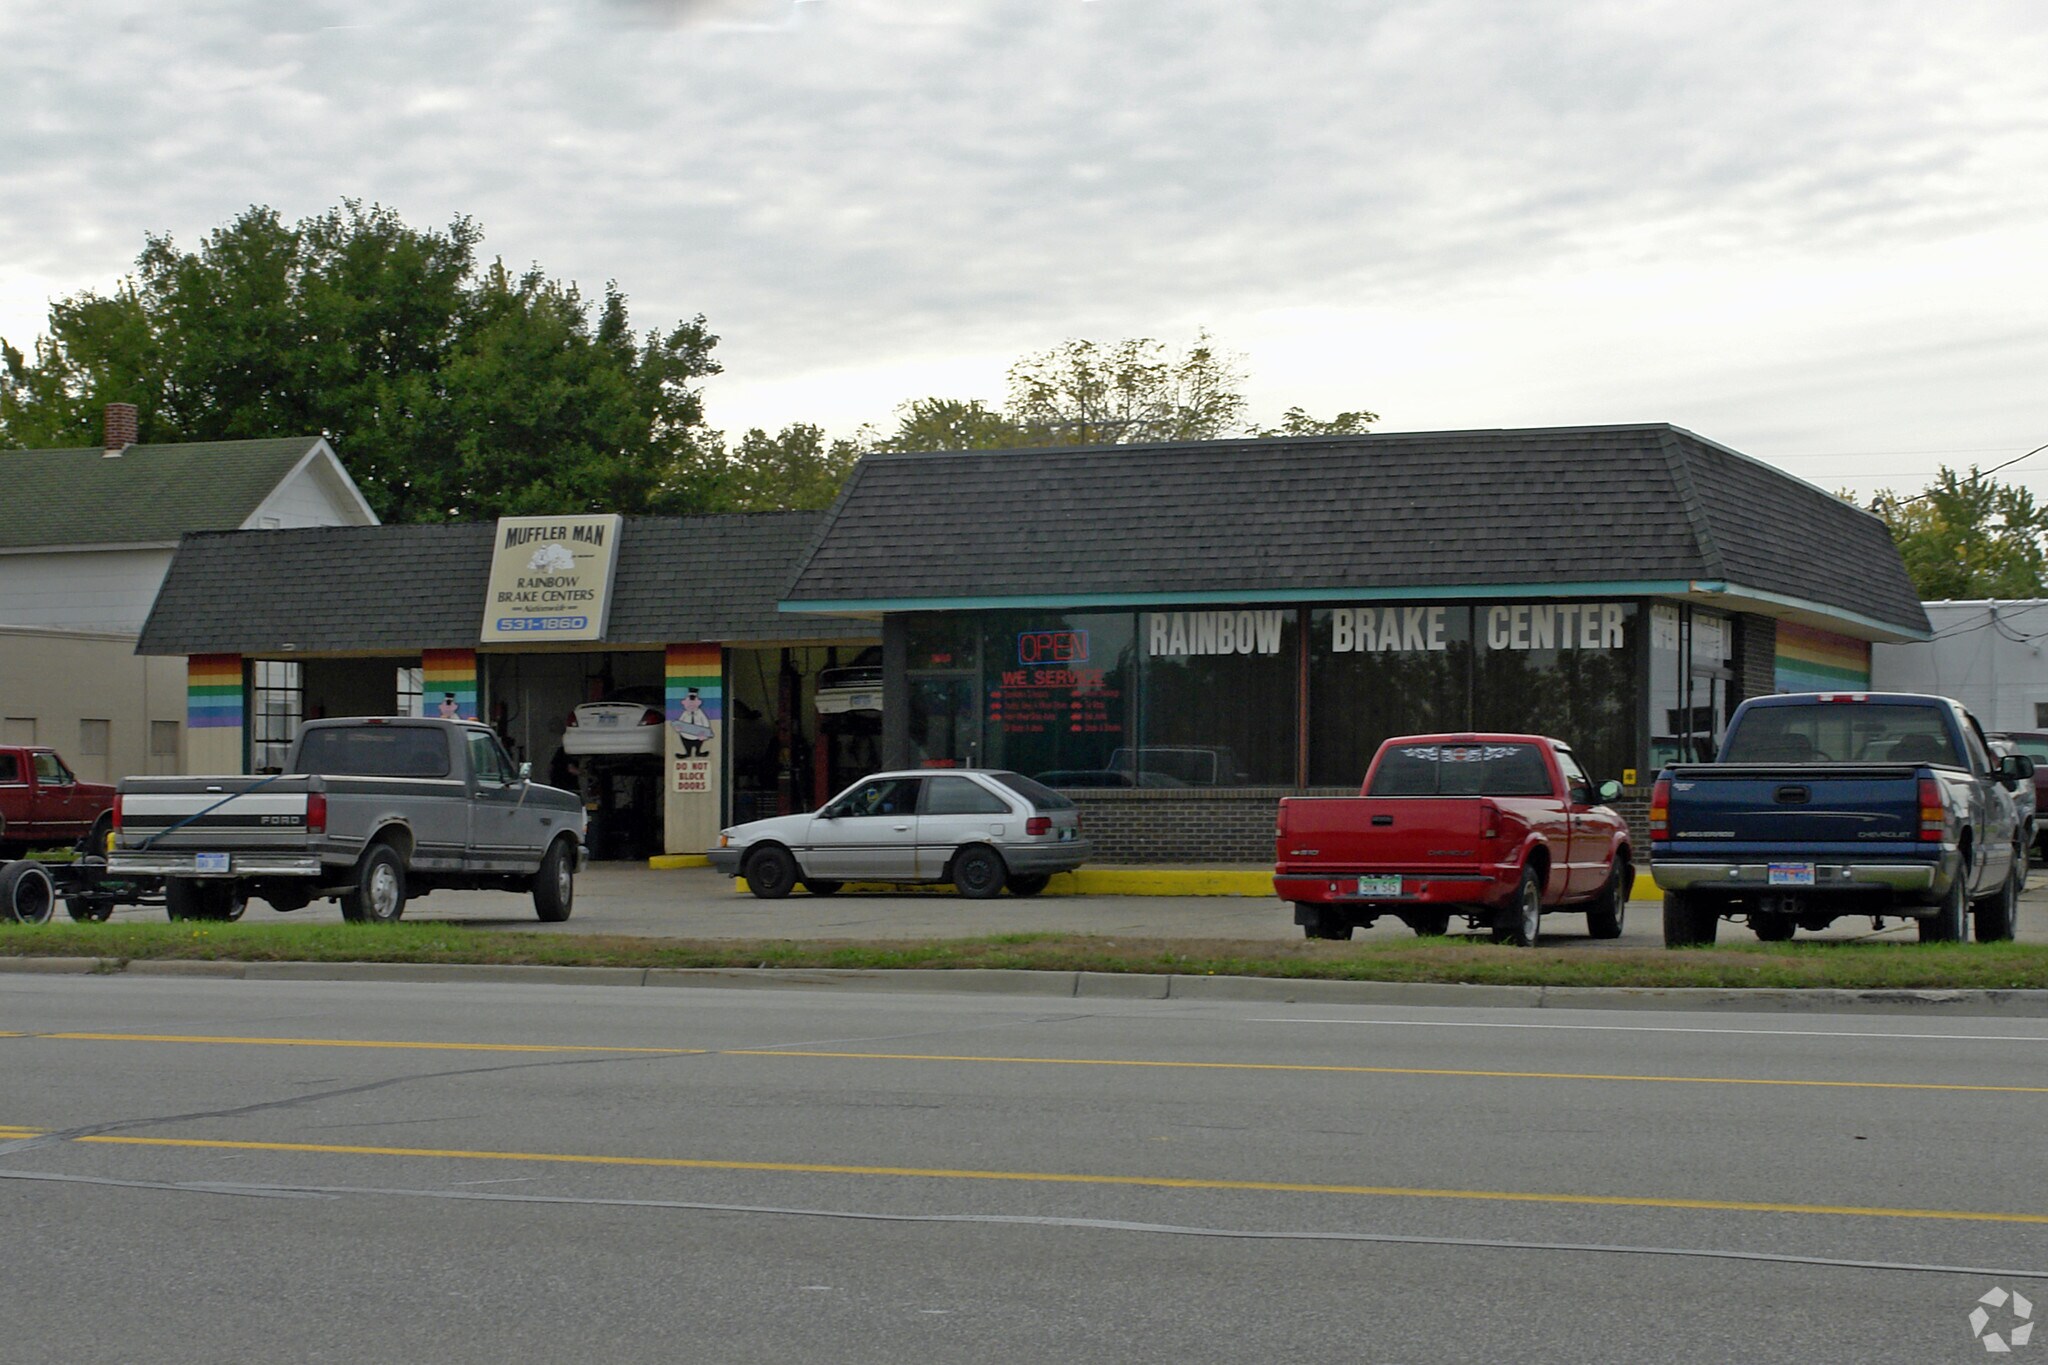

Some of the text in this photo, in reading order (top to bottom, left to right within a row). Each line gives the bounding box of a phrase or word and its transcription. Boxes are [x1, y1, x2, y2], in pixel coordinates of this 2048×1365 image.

[504, 525, 605, 549] MUFFLER MAN
[516, 576, 580, 588] RAINBOW
[497, 589, 595, 602] BRAKE CENTERS
[500, 618, 585, 630] 531-1860
[1149, 610, 1284, 656] RAINBOW
[1332, 606, 1447, 653] BRAKE
[1487, 604, 1625, 650] CENTER
[1021, 633, 1087, 661] OPEN
[1001, 669, 1105, 685] WE SERVICE
[676, 762, 709, 770] DO NOT
[678, 772, 705, 780] BLOCK
[677, 782, 706, 790] DOORS
[261, 816, 300, 825] FORD
